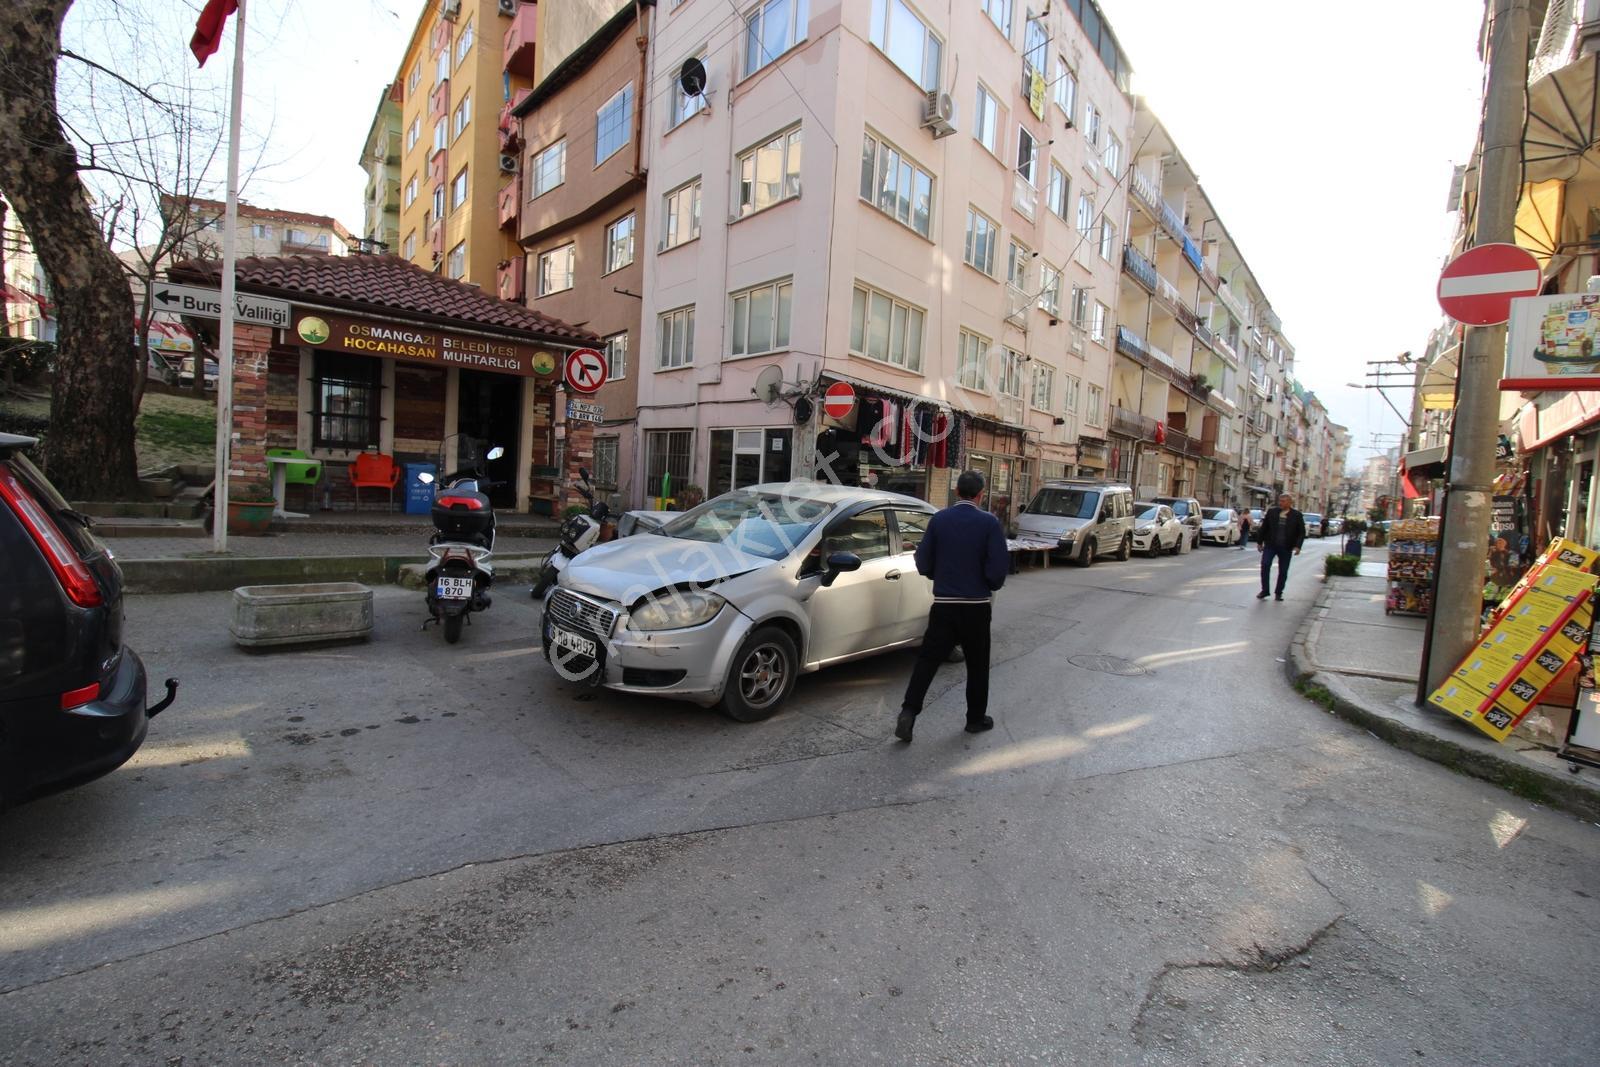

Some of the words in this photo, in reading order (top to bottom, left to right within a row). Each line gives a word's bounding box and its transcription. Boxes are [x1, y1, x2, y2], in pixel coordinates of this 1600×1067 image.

[183, 295, 222, 314] Burs
[236, 303, 287, 324] Valiliği
[344, 337, 436, 358] HOCAHASAN
[443, 351, 521, 370] MUHTARLIĞI
[349, 324, 436, 346] OSMANGAZİ
[443, 337, 518, 357] BELEDİYESİ
[440, 579, 450, 587] 16
[454, 579, 471, 587] BLH
[445, 587, 463, 595] 870
